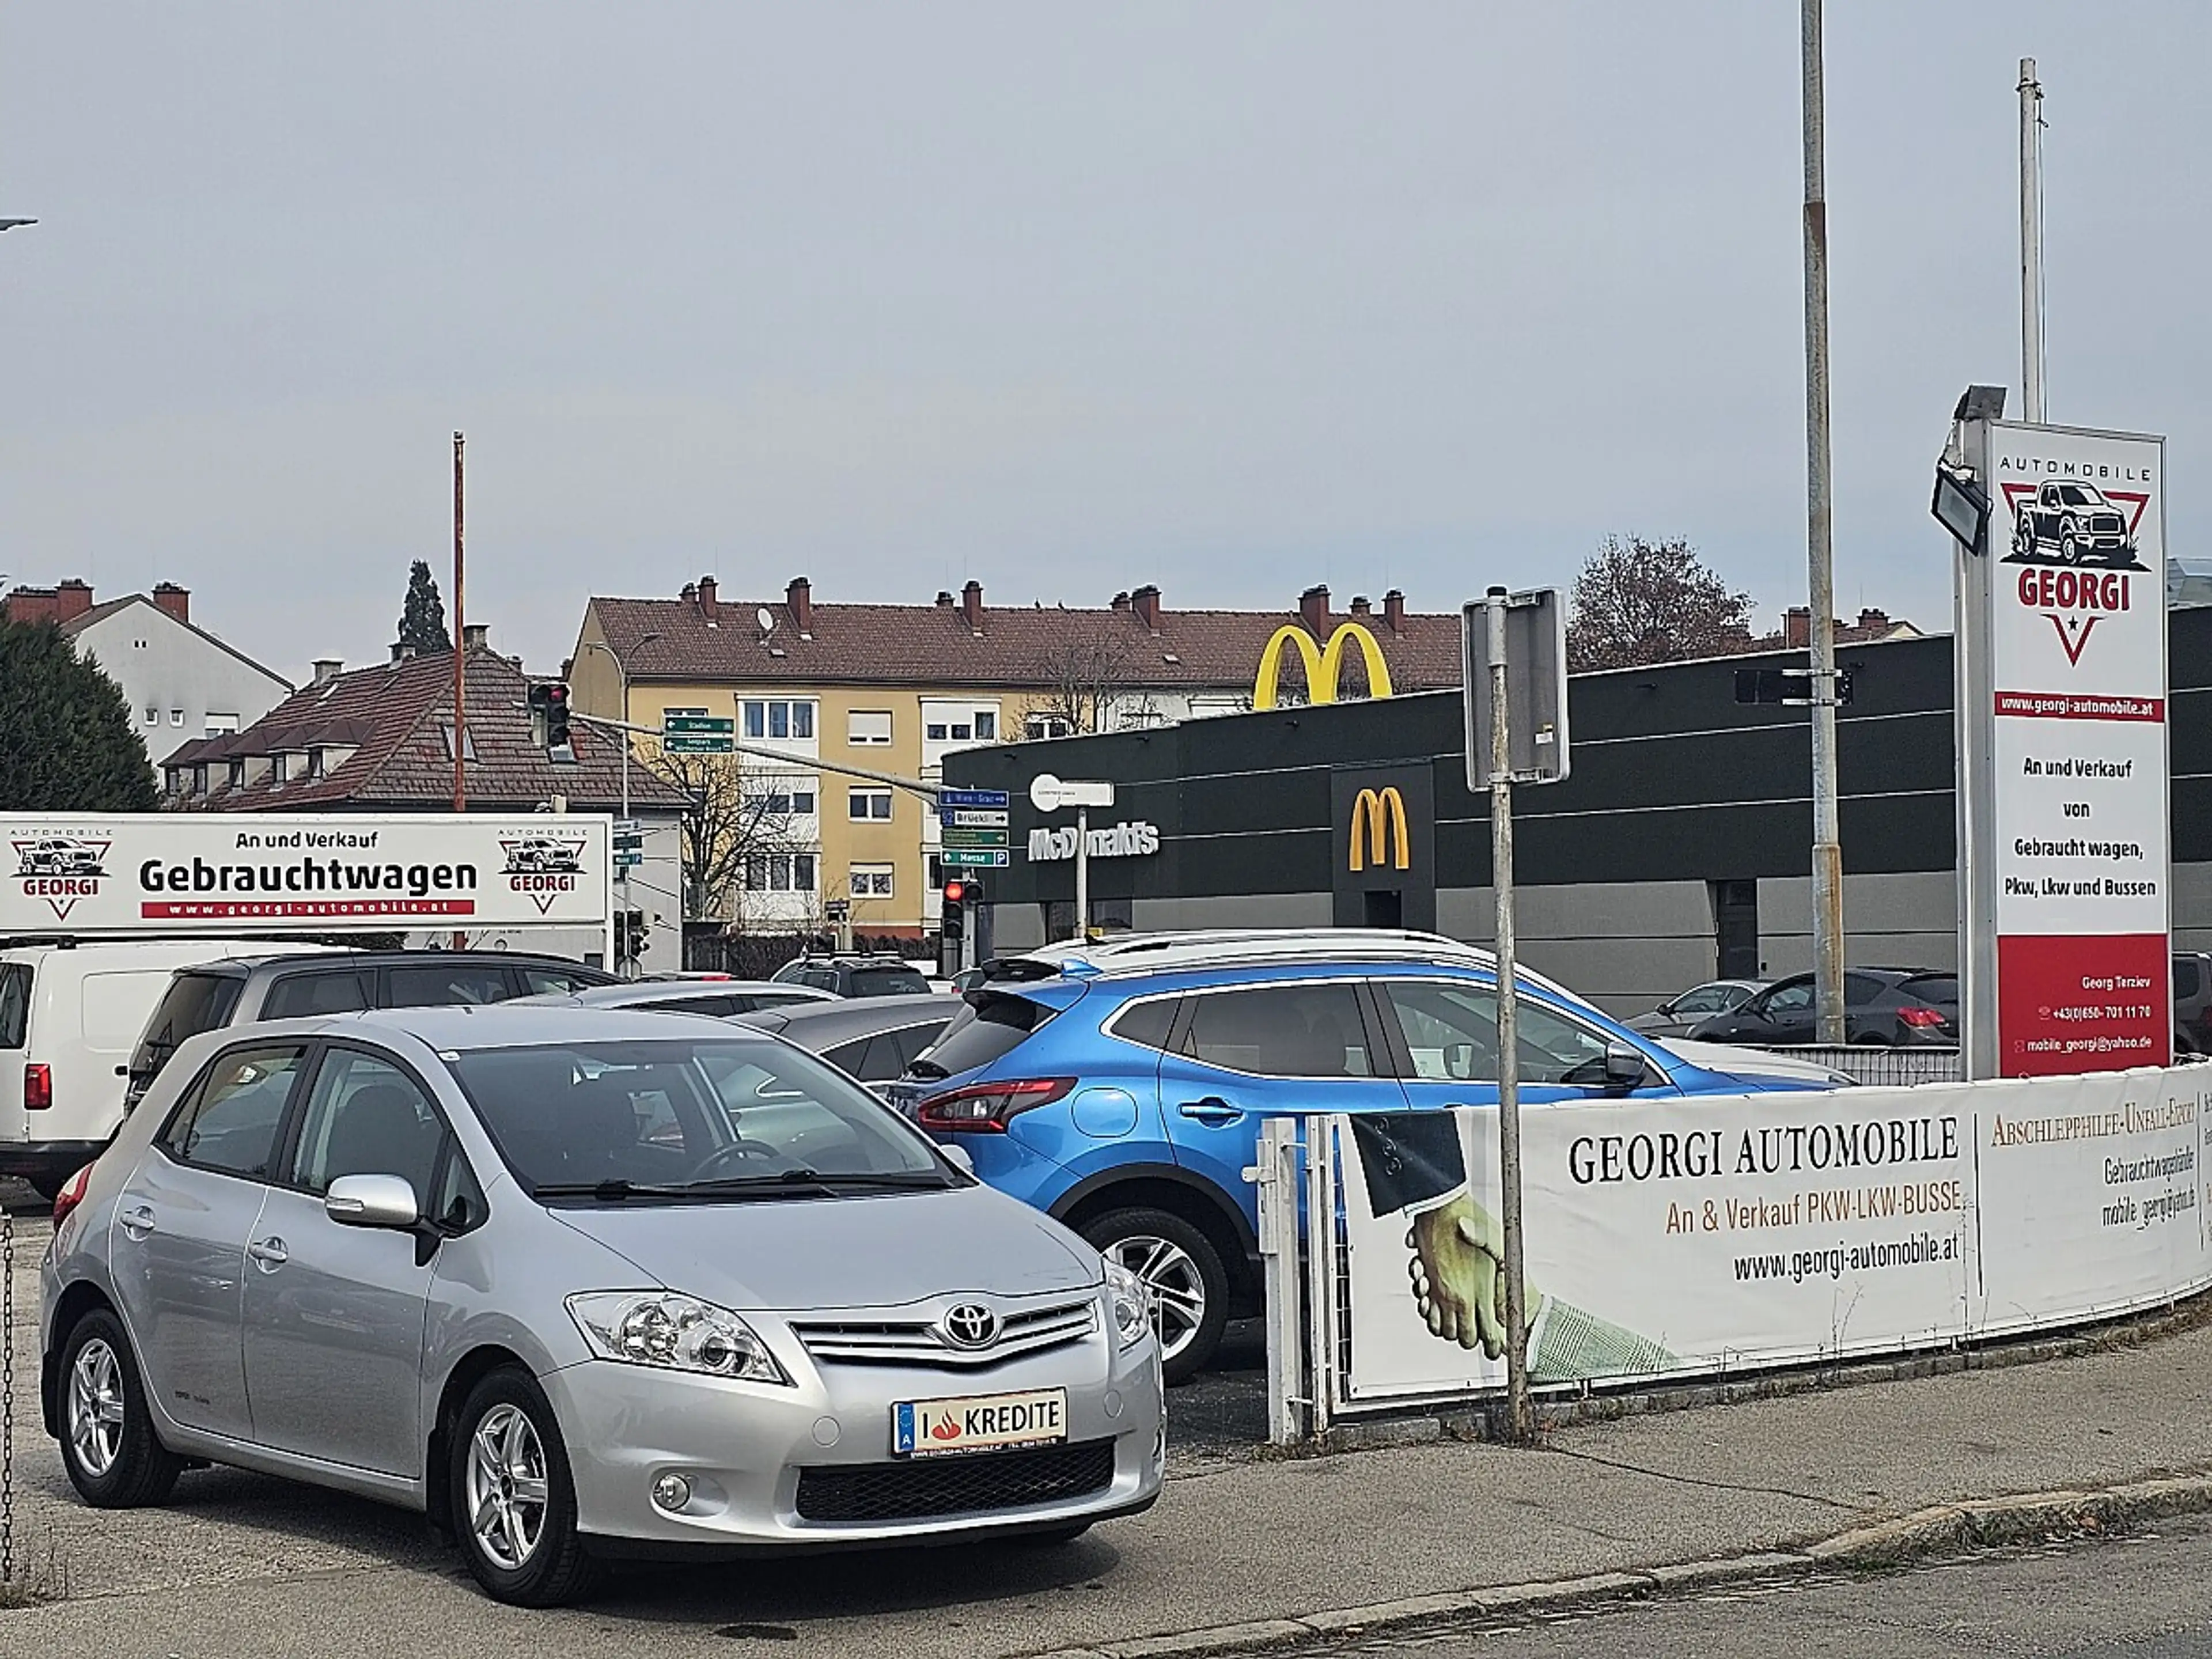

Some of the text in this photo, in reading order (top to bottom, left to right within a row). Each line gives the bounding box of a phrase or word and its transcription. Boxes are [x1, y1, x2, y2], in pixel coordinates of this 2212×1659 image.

[2000, 457, 2150, 481] AUTOMOBILE
[2018, 568, 2130, 611] GEORGI
[2002, 696, 2154, 717] www.georgi-automobile.at
[2024, 757, 2132, 778] An und Verkauf
[2063, 803, 2090, 817] von
[236, 831, 378, 848] An und Verkauf
[1028, 821, 1158, 861] McDnald's
[997, 854, 1005, 863] P
[24, 879, 99, 895] GEORGI
[140, 857, 477, 896] Gebrauchtwagen
[510, 876, 575, 891] GEORGI
[2005, 877, 2156, 898] Pkw, Lkw und Bussen
[169, 902, 448, 915] www.georgi-automobile.at
[2082, 975, 2150, 990] Georg Terziev
[2028, 1036, 2152, 1054] mobile_georgi@yahoo.de
[1569, 1117, 1959, 1184] GEORGI AUTOMOBILE
[1666, 1181, 1961, 1234] An & Verkauf PKW-LKW-BUSSE
[1734, 1233, 1959, 1283] www.georgi-automobile.at
[923, 1401, 1059, 1439] I KREDITE
[903, 1434, 911, 1445] A
